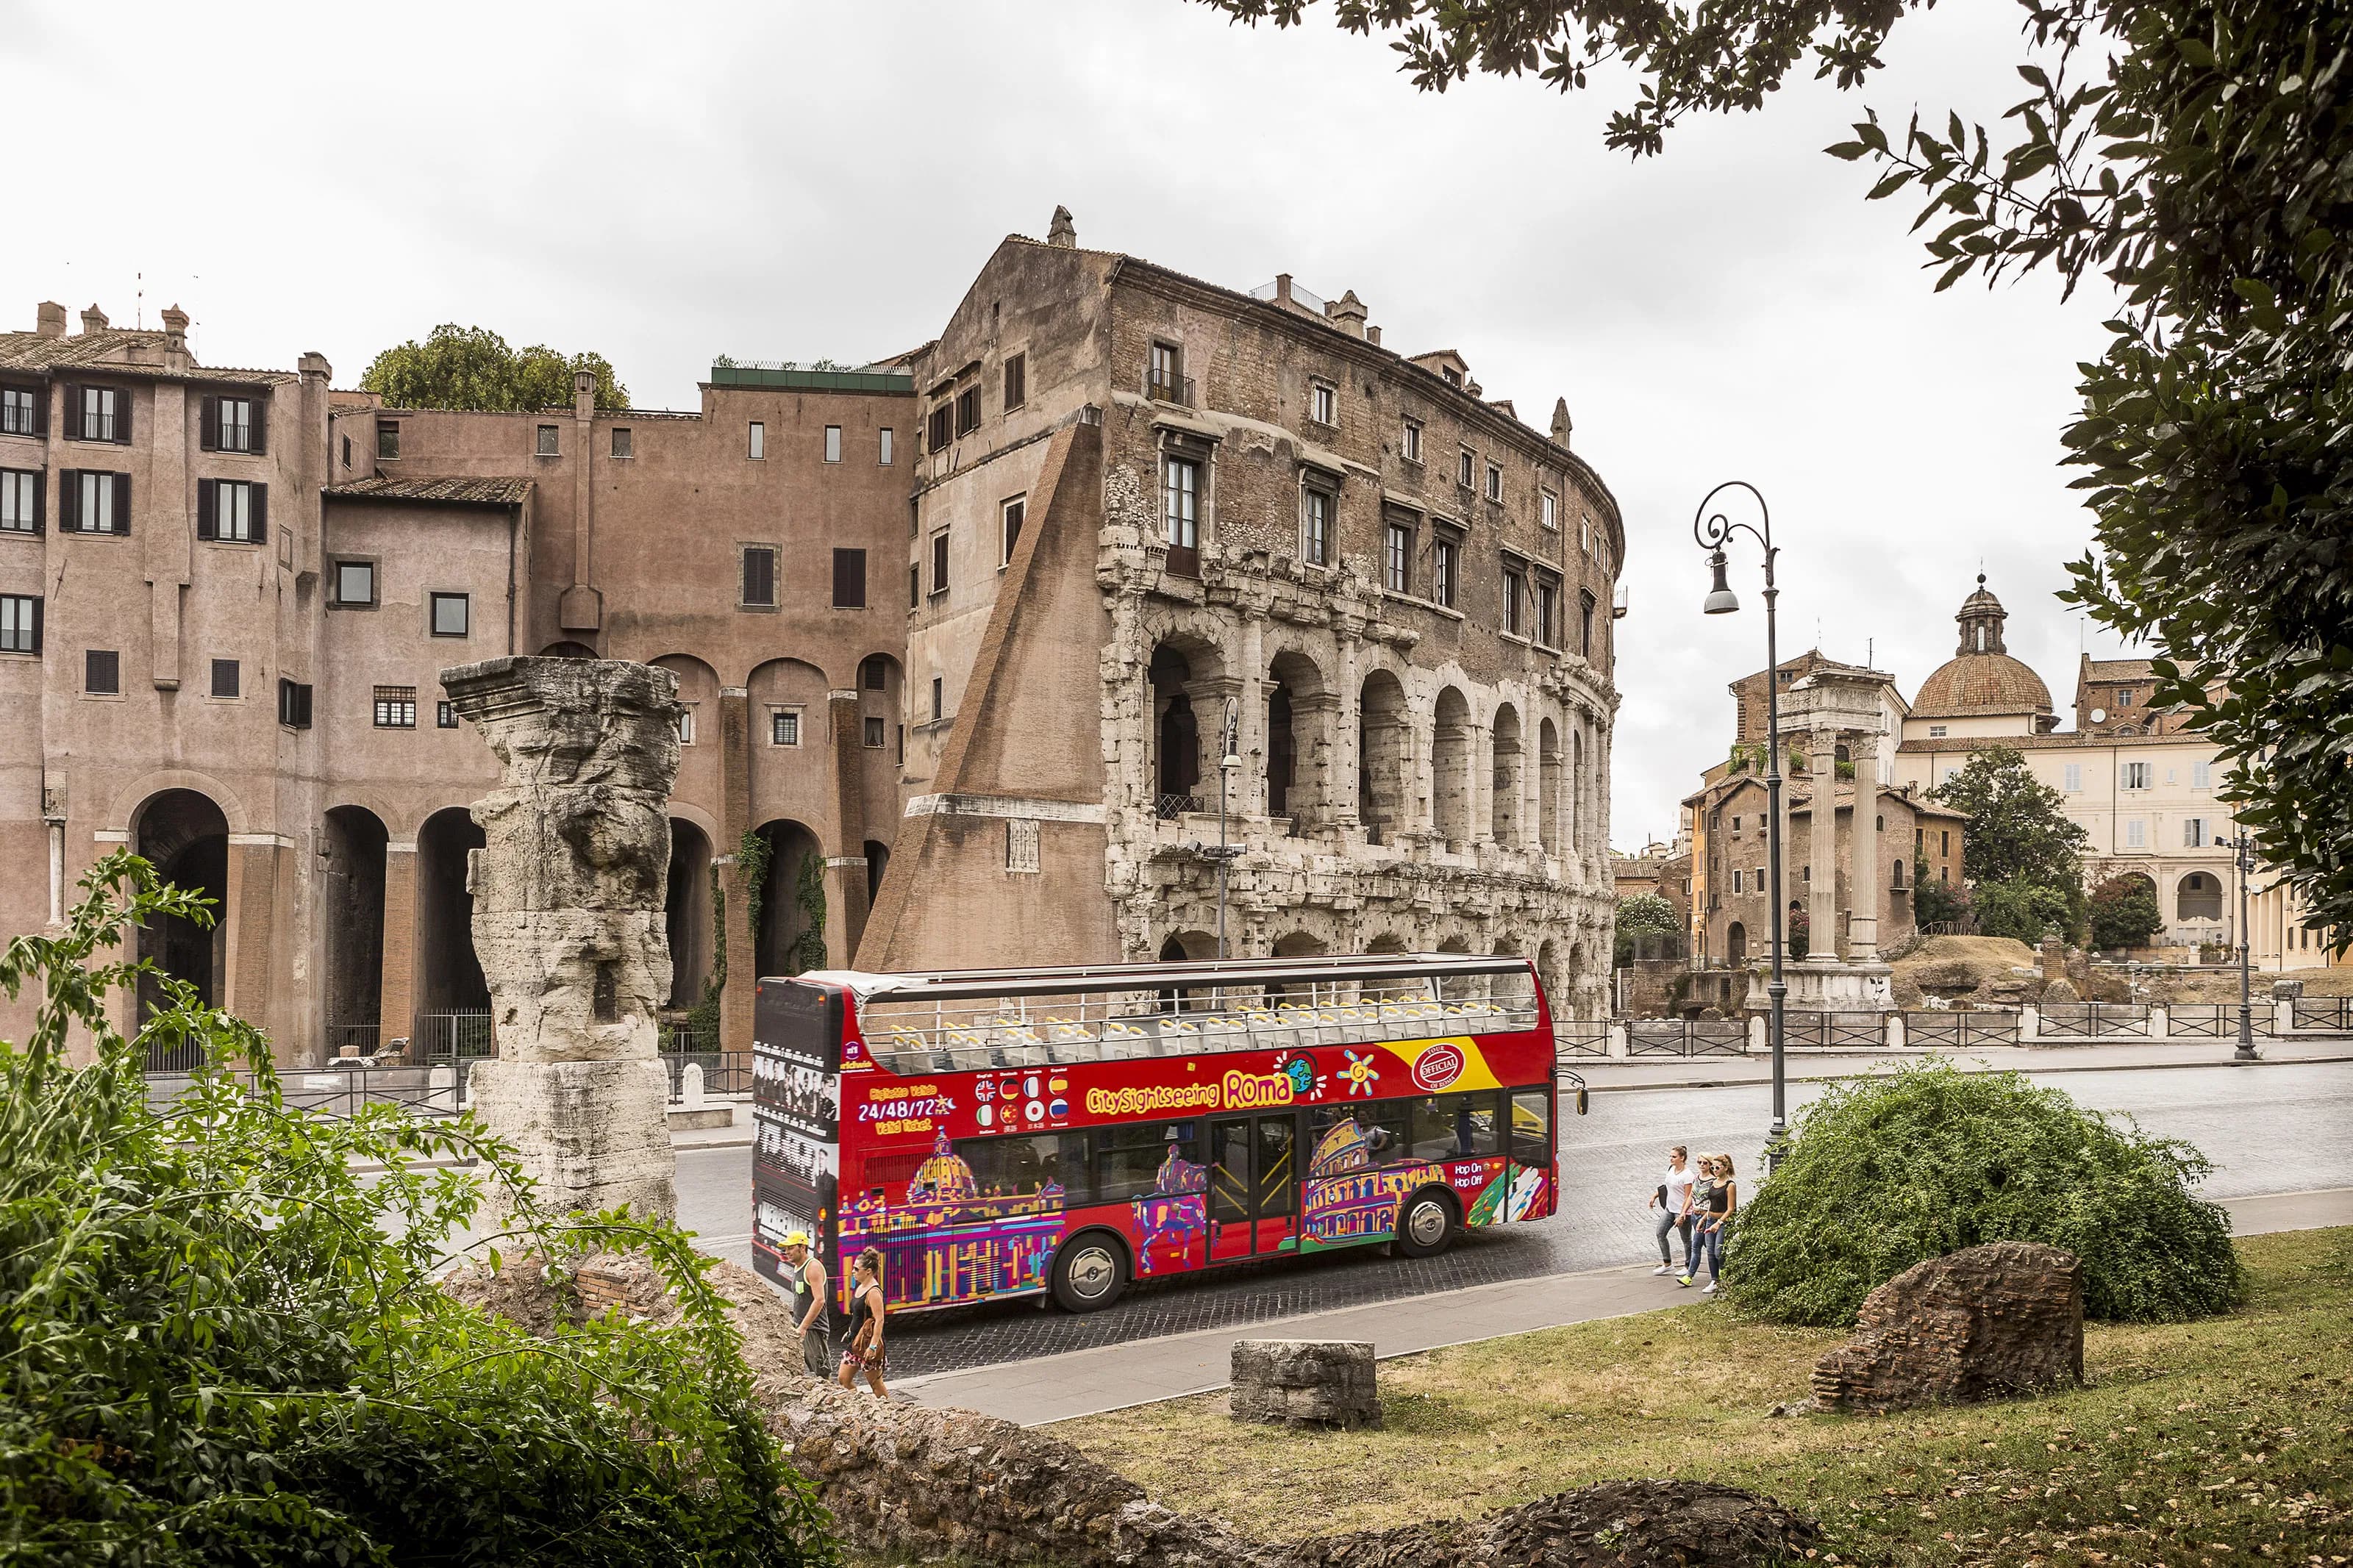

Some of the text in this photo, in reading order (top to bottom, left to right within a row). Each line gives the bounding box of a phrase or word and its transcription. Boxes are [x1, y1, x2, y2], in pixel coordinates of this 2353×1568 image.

[1427, 1045, 1445, 1055] TOUR
[1422, 1059, 1456, 1075] OFFICIAL
[869, 1084, 938, 1102] Biglietto Valido
[1087, 1070, 1293, 1115] CitySightseeing Roma
[858, 1098, 935, 1122] 24/48/72
[875, 1118, 933, 1135] Valid Ticket
[1455, 1163, 1482, 1175] Hop On
[1455, 1175, 1483, 1188] Hop Off
